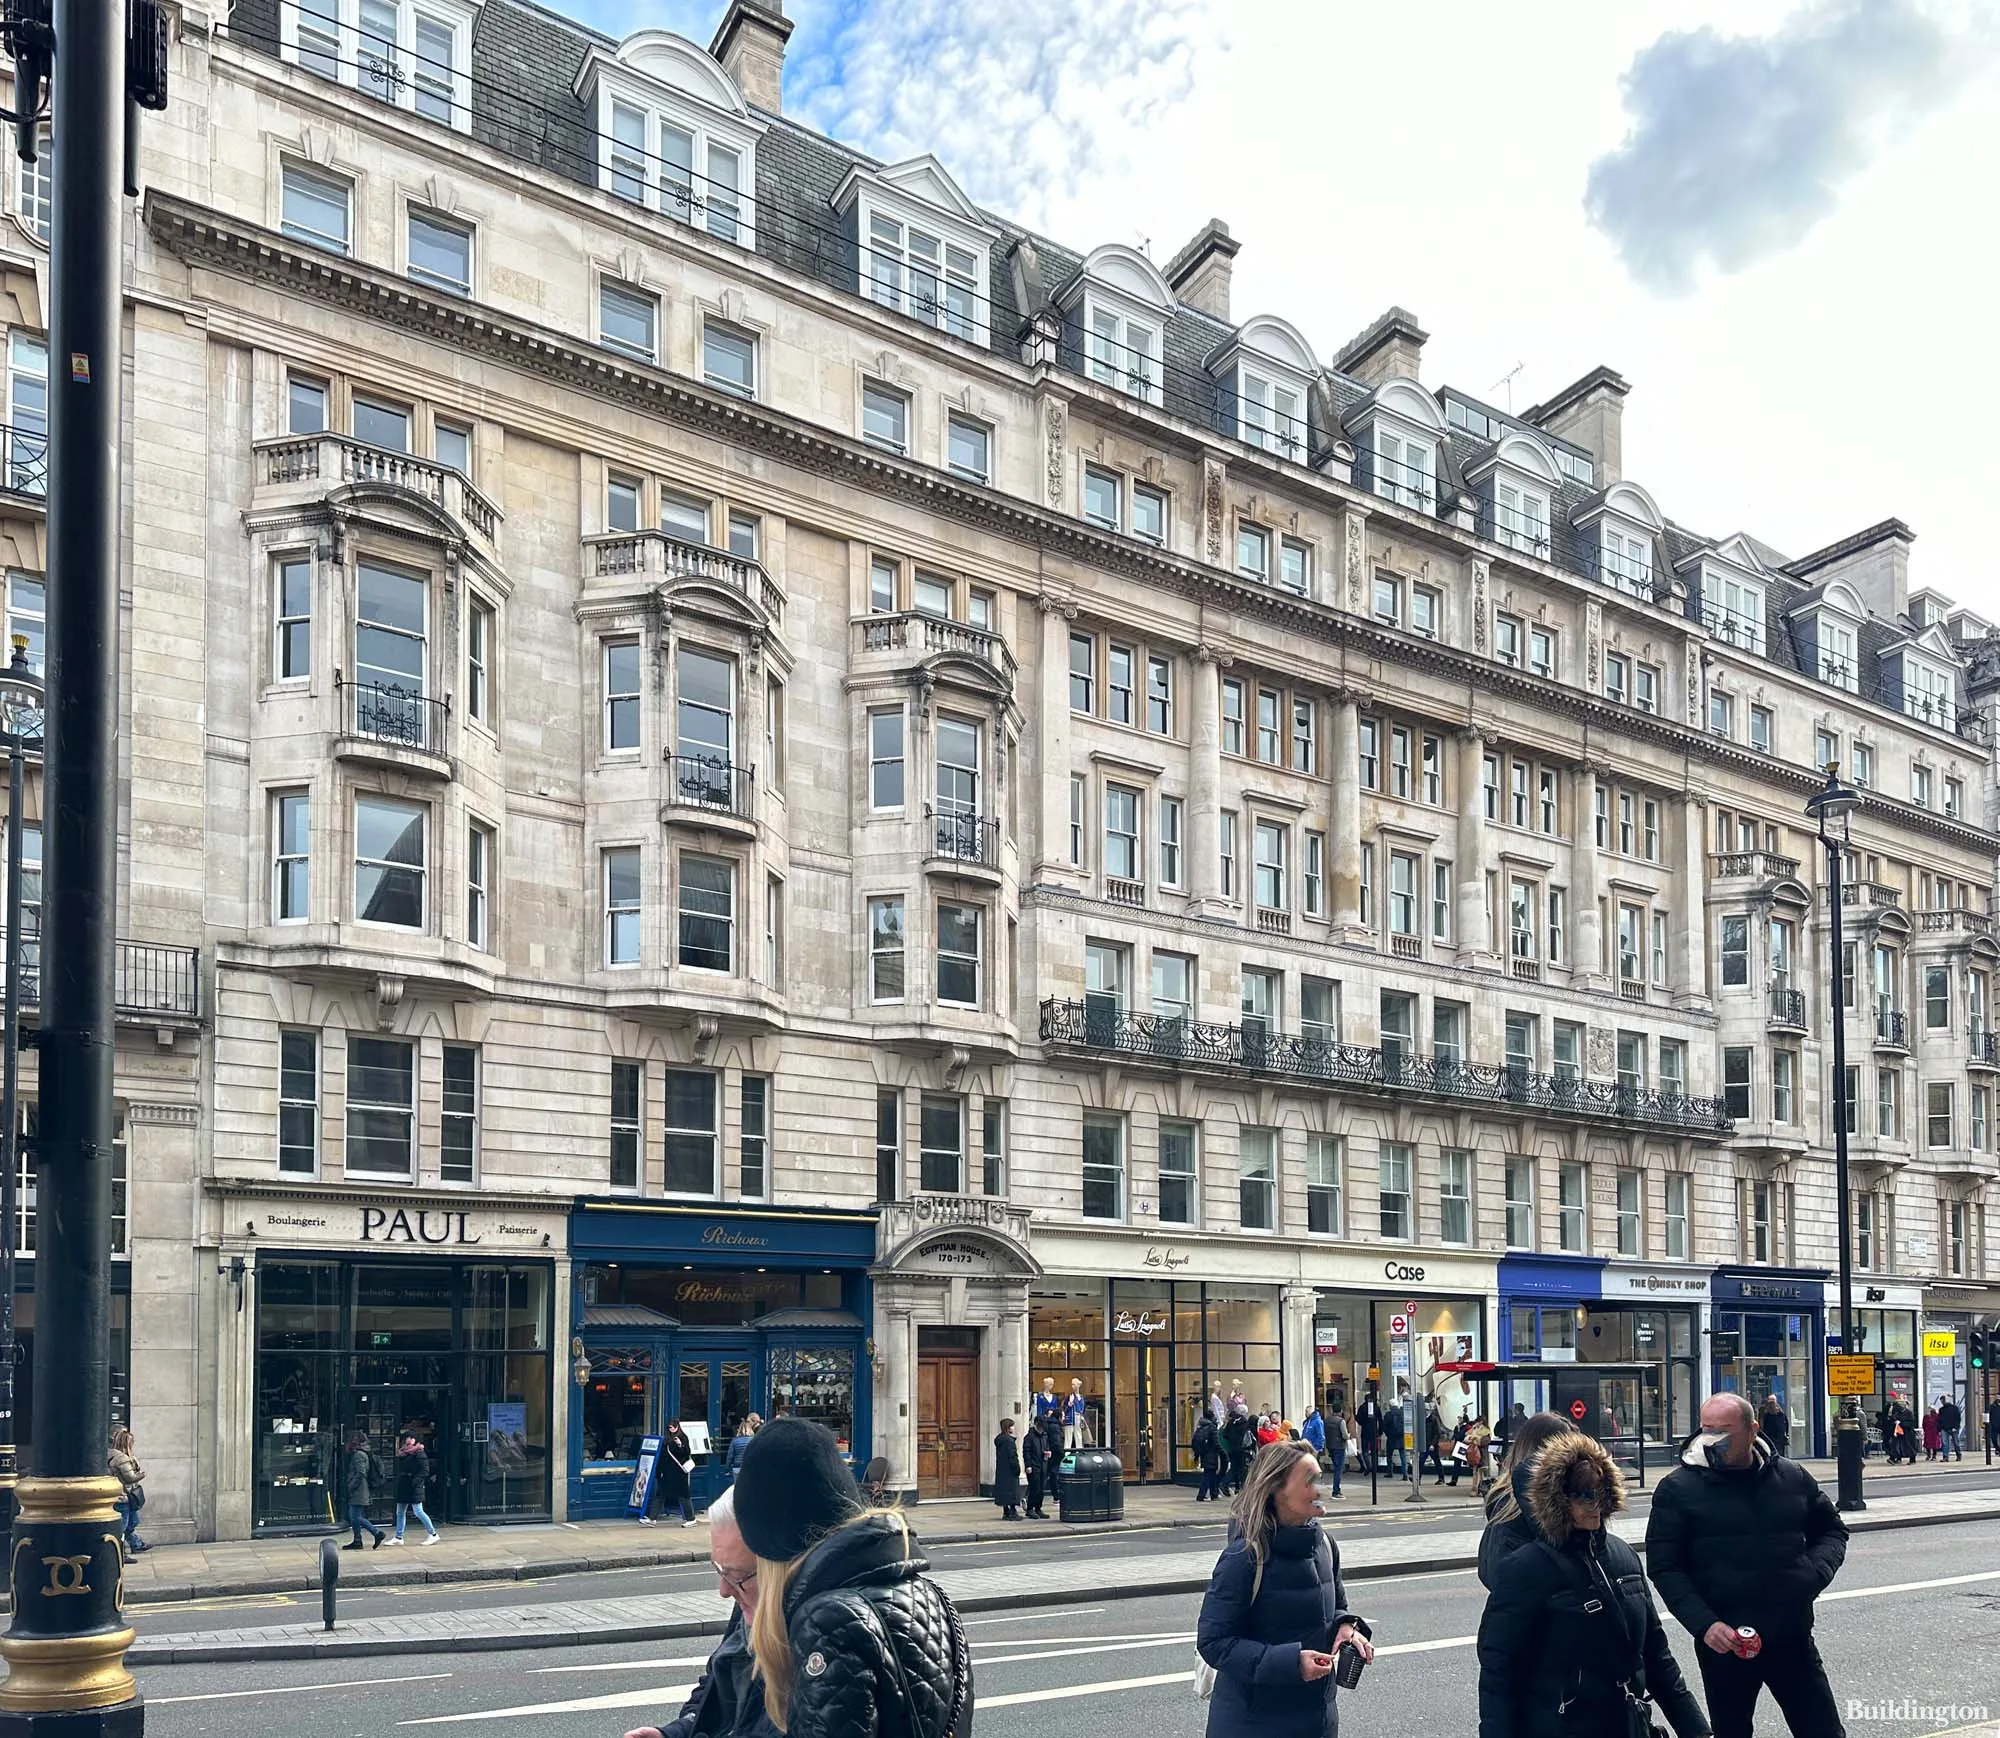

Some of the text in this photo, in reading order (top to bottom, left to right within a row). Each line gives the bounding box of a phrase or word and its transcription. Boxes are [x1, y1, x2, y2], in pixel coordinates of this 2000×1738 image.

[267, 1215, 327, 1227] Boulangerie
[359, 1207, 482, 1244] PAUL
[499, 1224, 538, 1235] Patisserie
[701, 1225, 769, 1247] Richoux
[919, 1243, 957, 1257] EGYPTIAN
[938, 1254, 972, 1263] 170-173
[1143, 1247, 1190, 1269] Luisa Spagnoli
[1384, 1261, 1425, 1281] Case
[1629, 1277, 1707, 1290] THE WHISKY SHOP
[1406, 1302, 1415, 1313] G
[1113, 1311, 1167, 1336] Luisa Spagnoli
[1929, 1338, 1949, 1349] itsu
[1939, 1357, 1950, 1366] LET
